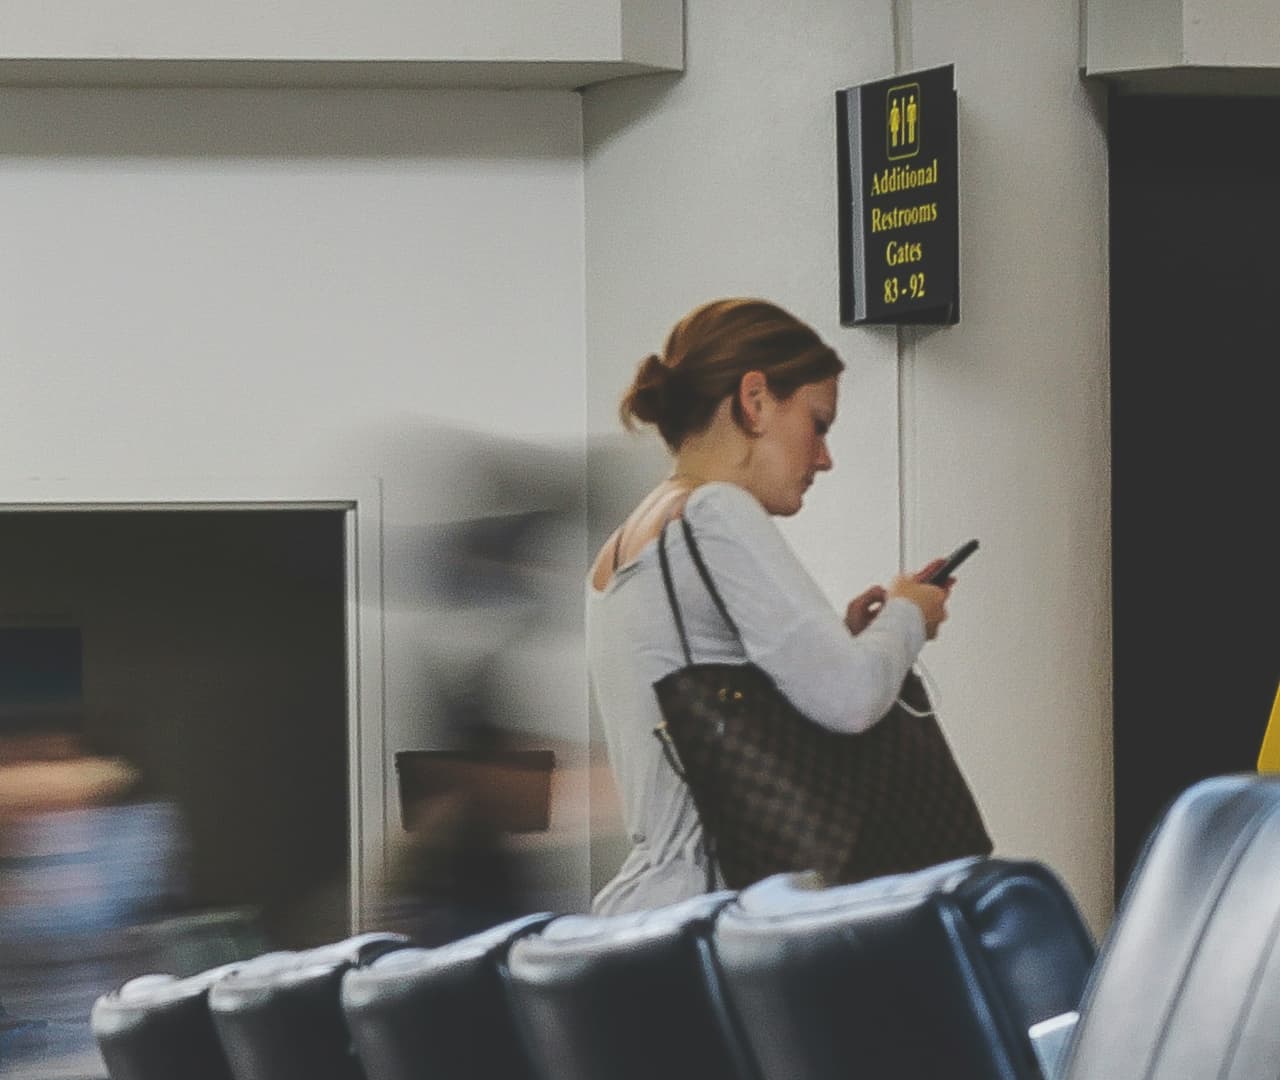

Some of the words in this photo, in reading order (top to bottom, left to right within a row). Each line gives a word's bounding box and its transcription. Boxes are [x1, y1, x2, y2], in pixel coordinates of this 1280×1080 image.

[870, 158, 938, 197] Additional
[871, 202, 938, 233] Restrooms
[886, 240, 922, 266] Gates
[884, 277, 898, 304] 83
[910, 272, 925, 299] 92
